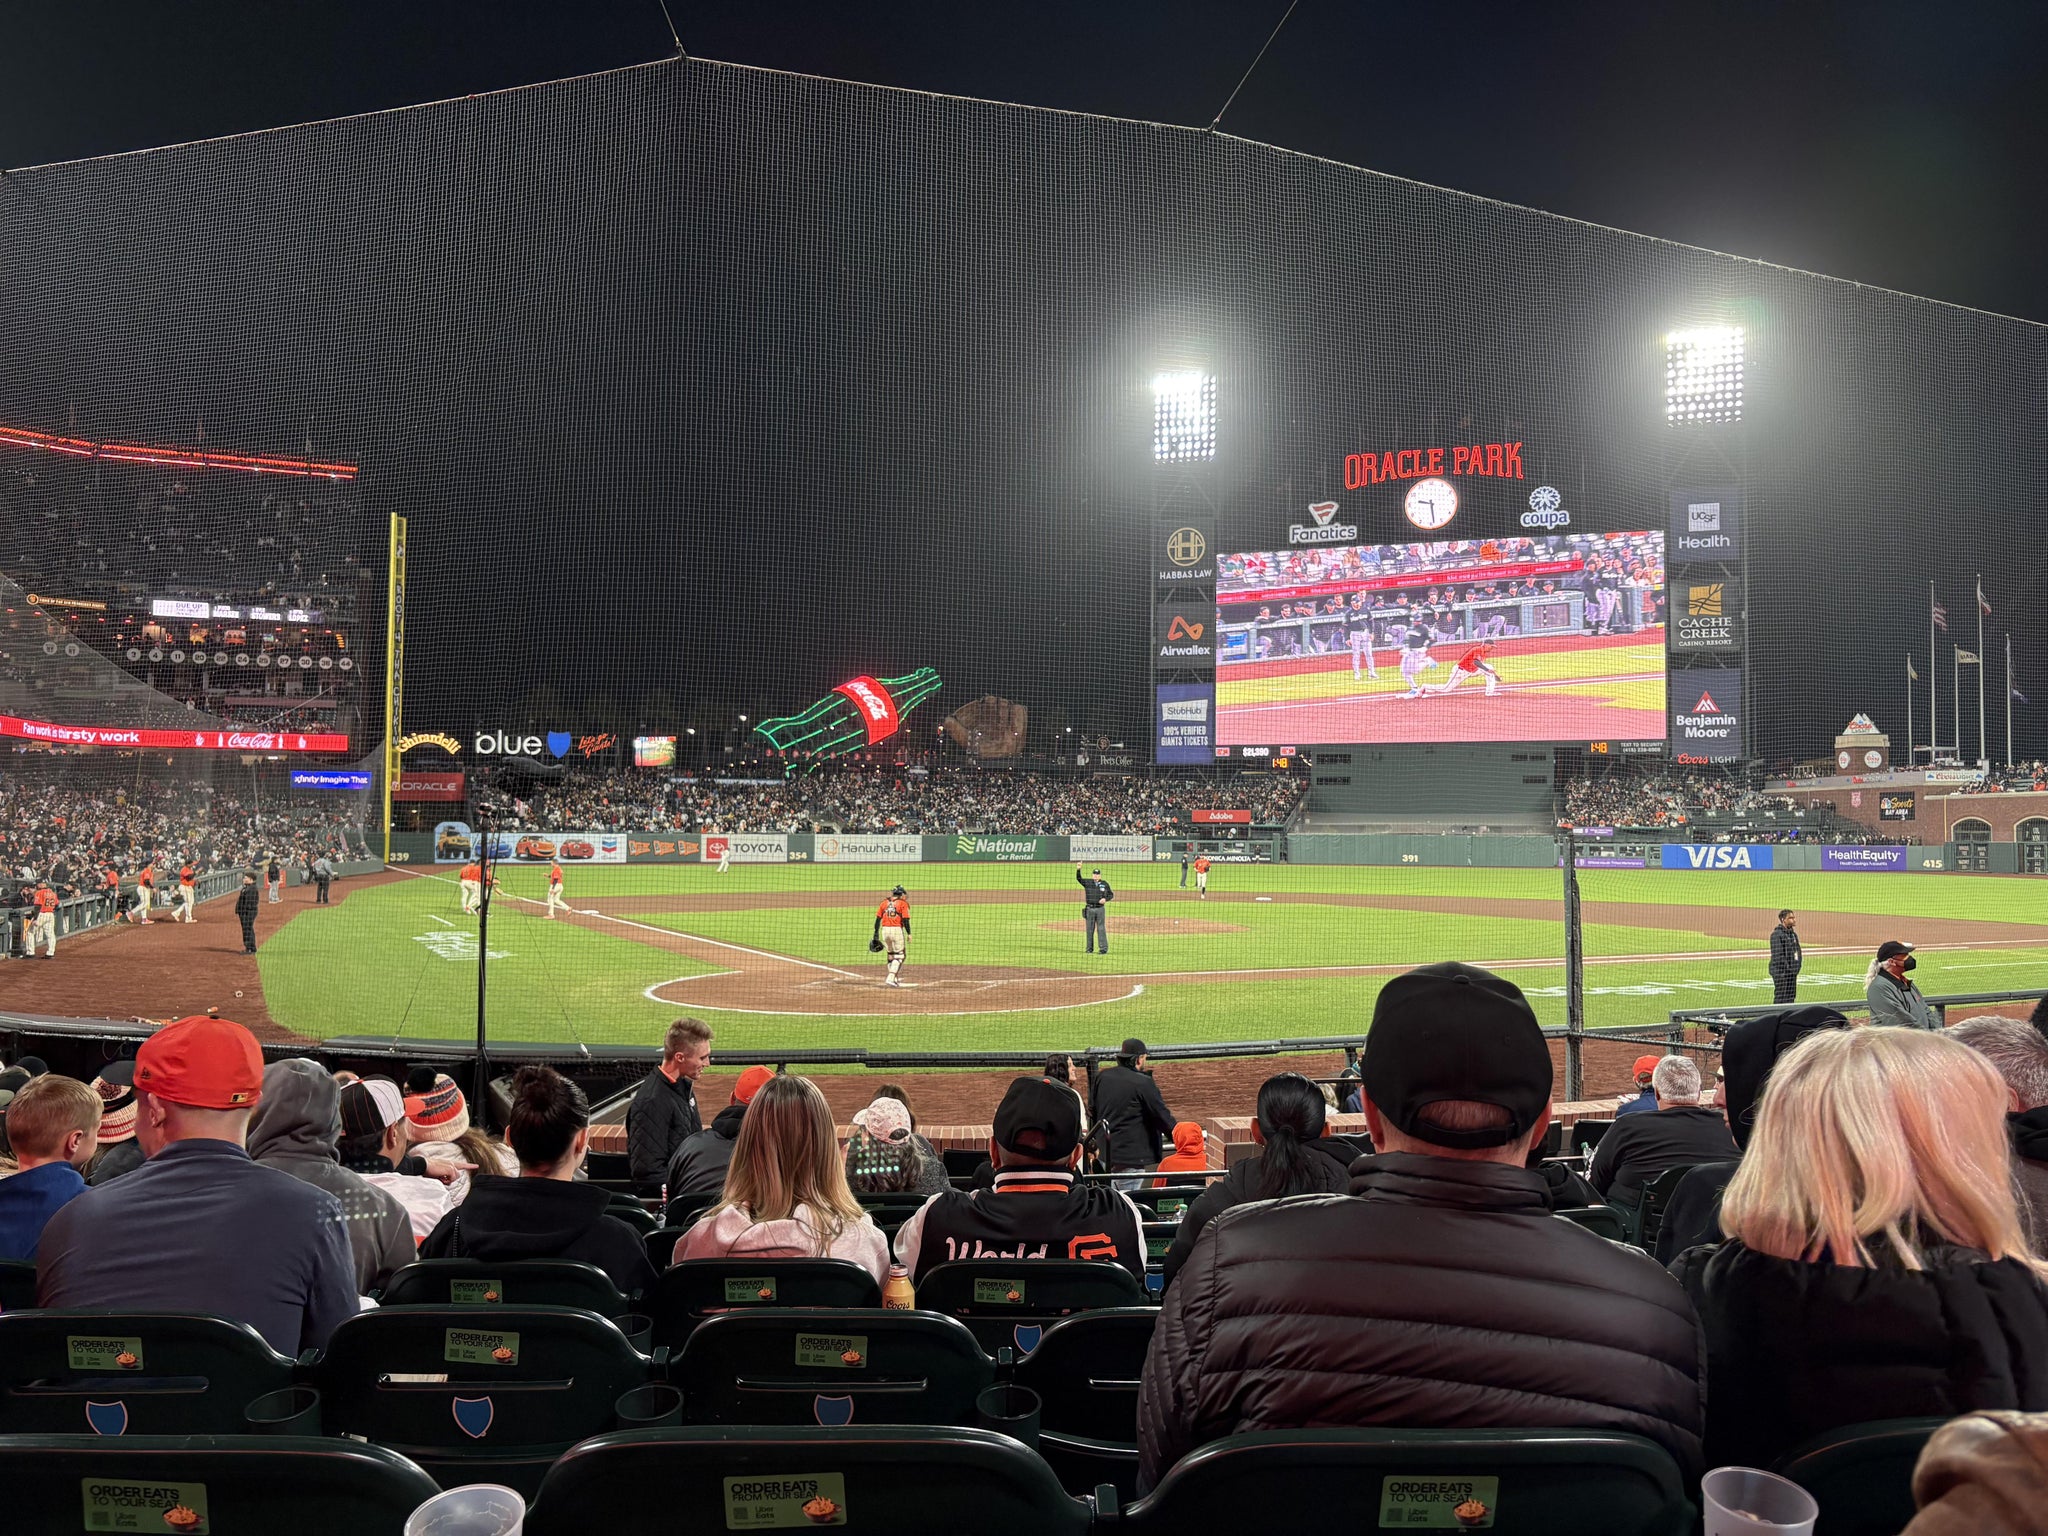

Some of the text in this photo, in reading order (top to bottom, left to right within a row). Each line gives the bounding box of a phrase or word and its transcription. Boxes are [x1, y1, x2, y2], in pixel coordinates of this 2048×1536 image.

[1344, 441, 1524, 490] ORACLE PARK
[1522, 511, 1568, 528] coupa
[1691, 511, 1716, 523] UCSF
[1291, 523, 1356, 541] Fanatics
[1678, 534, 1730, 549] Health
[1160, 569, 1212, 580] HABBAS LAW
[1678, 617, 1732, 628] CACHE
[1680, 628, 1730, 639] CREEK
[1160, 645, 1210, 656] Airwallex
[1167, 706, 1201, 715] StubHub
[1676, 715, 1736, 729] Benjamin
[23, 722, 35, 734] Fan
[36, 725, 51, 736] work
[58, 729, 96, 742] thirsty
[100, 732, 140, 742] work
[1163, 726, 1206, 735] 100% VERIFIED
[1685, 726, 1728, 738] Moore
[396, 733, 462, 755] Ghirardelli
[475, 729, 542, 755] blue
[1161, 736, 1208, 746] GIANTS TICKETS
[1677, 753, 1736, 764] Coors LIGHT
[320, 776, 350, 785] Imagine
[350, 776, 368, 784] That
[401, 781, 456, 791] ORACLE
[1891, 797, 1913, 810] Sports
[1209, 812, 1233, 821] Adobe
[732, 843, 783, 853] TOYOTA
[841, 843, 916, 853] Hanwha Life
[976, 838, 1037, 854] National
[390, 852, 409, 862] 339
[789, 852, 807, 860] 354
[996, 853, 1033, 861] Car Rental
[1156, 852, 1171, 860] 399
[1401, 854, 1418, 863] 391
[1682, 846, 1752, 869] VISA
[1828, 850, 1899, 862] HealthEquity
[1923, 860, 1942, 868] 415
[450, 1332, 503, 1343] ORDER EATS
[800, 1337, 852, 1347] ORDER EATS
[72, 1340, 102, 1348] ORDER
[90, 1485, 180, 1499] ORDER EATS
[731, 1480, 818, 1495] ORDER EATS
[1389, 1482, 1473, 1493] ORDER EATS
[733, 1491, 818, 1502] FROM YOUR SEAT
[1390, 1493, 1472, 1502] TO YOUR SEAT
[93, 1497, 180, 1508] TO YOUR SEAT
